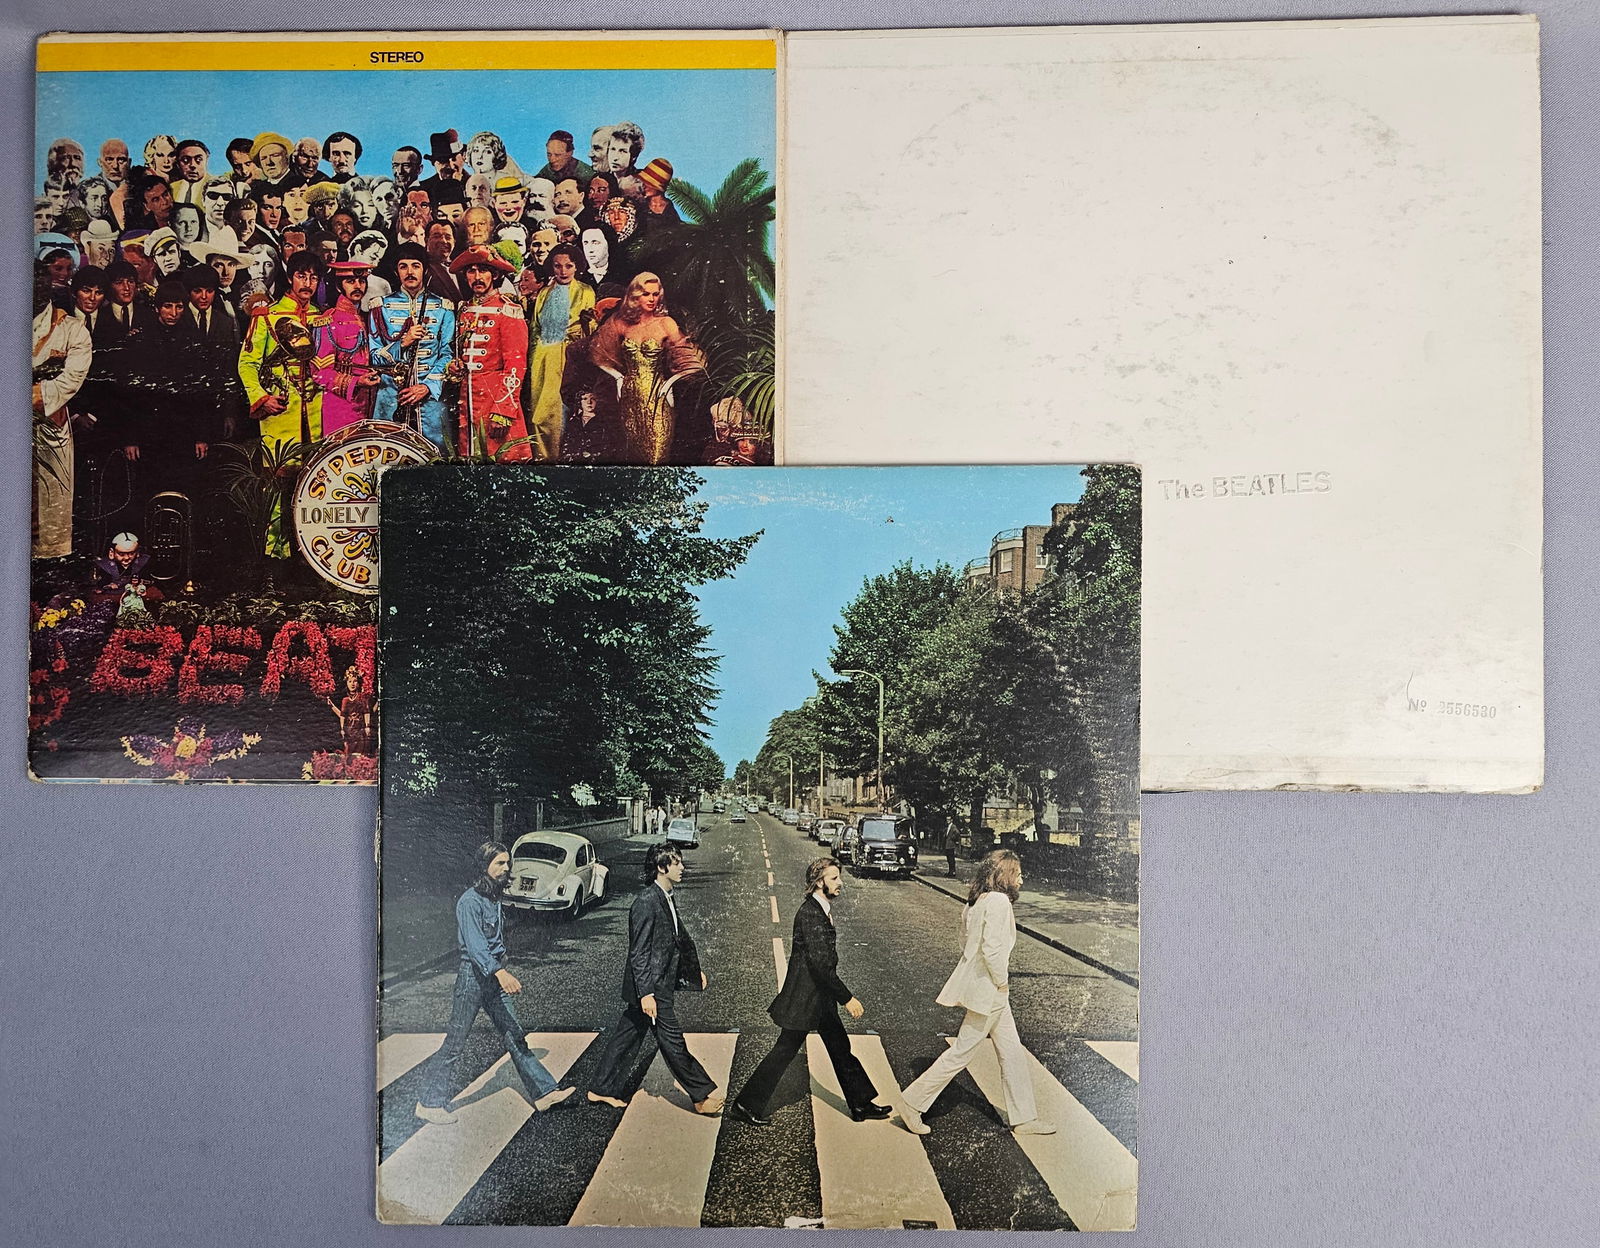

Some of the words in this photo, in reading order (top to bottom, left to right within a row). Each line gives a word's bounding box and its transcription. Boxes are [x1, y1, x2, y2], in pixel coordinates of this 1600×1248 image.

[370, 51, 424, 63] STEREO
[1158, 479, 1205, 500] The
[1212, 470, 1333, 499] BEATLES
[301, 506, 370, 524] LONELY
[311, 536, 371, 584] CLUB
[88, 620, 378, 704] BEAT
